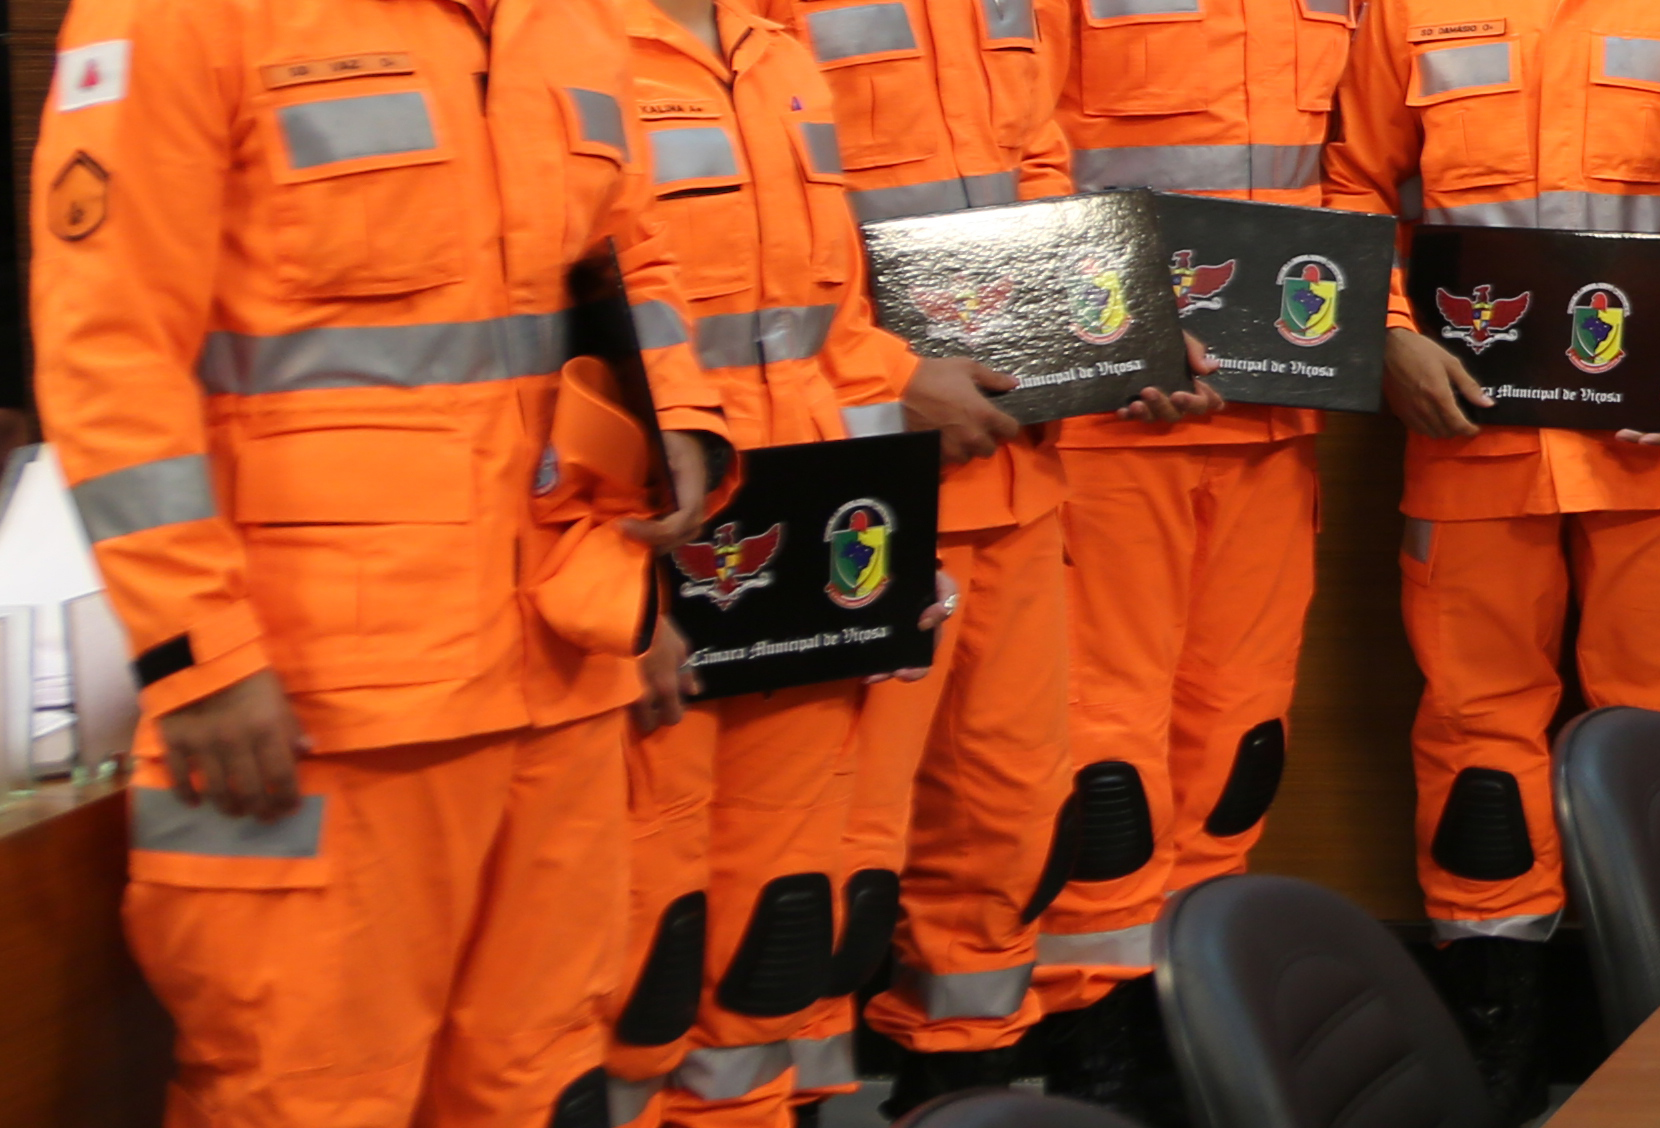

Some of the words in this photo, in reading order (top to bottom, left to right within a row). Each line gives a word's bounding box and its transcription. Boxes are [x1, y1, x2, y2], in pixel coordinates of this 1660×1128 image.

[1078, 366, 1094, 380] de
[1095, 360, 1143, 376] Viçosa
[1271, 360, 1286, 373] de
[1290, 360, 1335, 377] Viçosa
[1496, 384, 1559, 401] Municipal
[1562, 388, 1577, 400] de
[1580, 387, 1622, 404] Viçosa
[748, 634, 820, 660] Municipal
[823, 633, 838, 646] de
[842, 626, 888, 643] Viçosa
